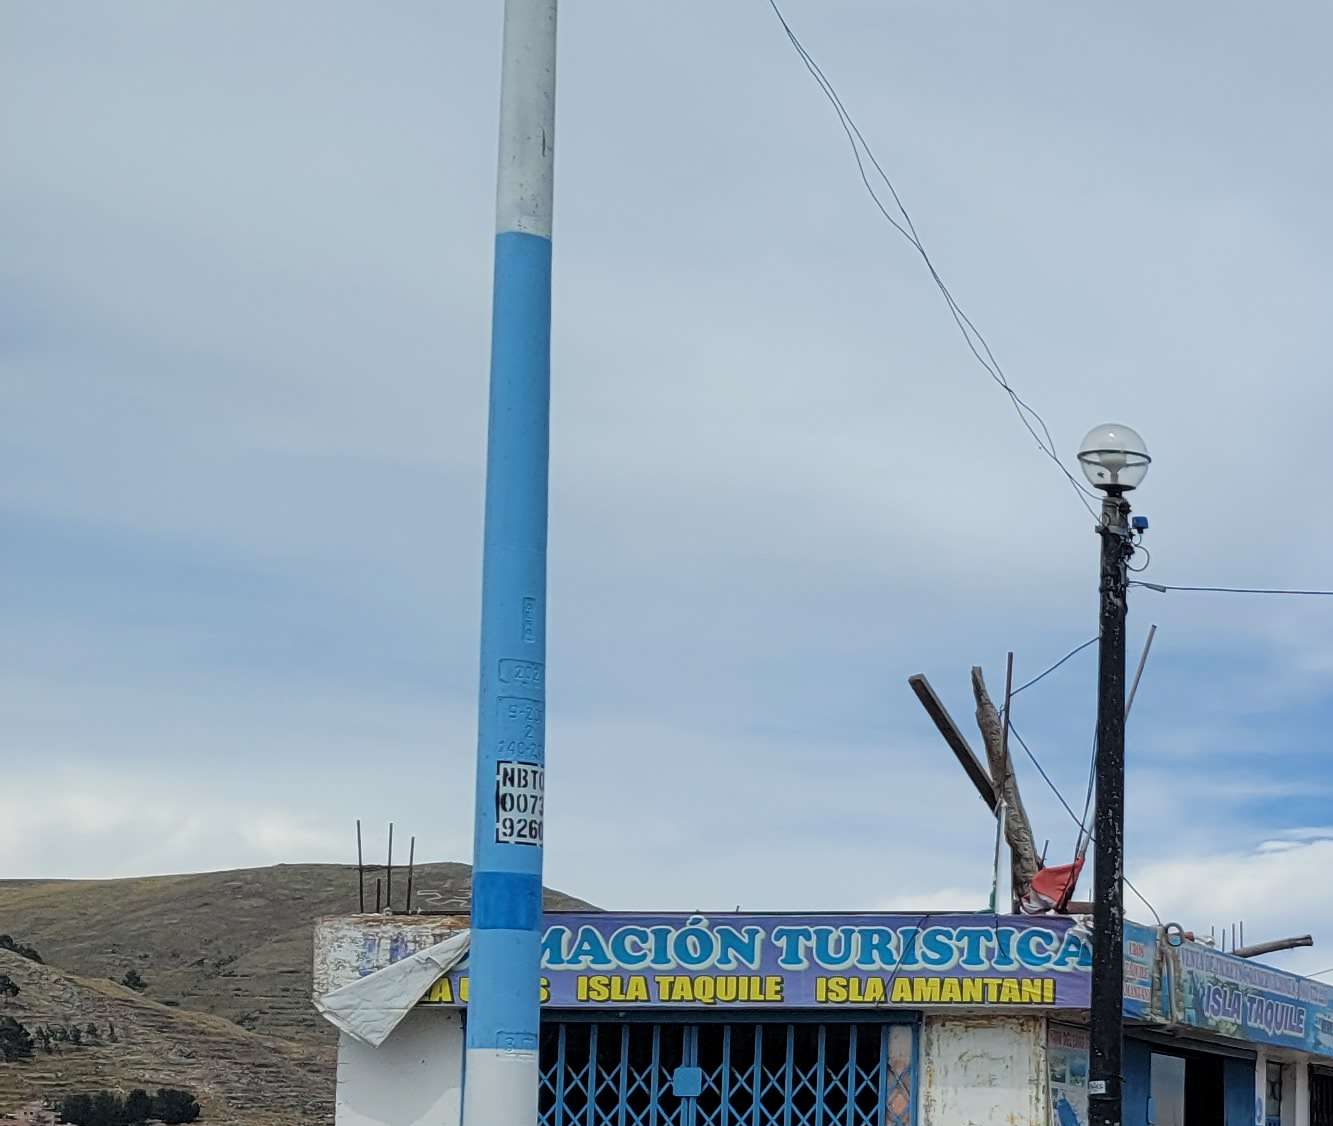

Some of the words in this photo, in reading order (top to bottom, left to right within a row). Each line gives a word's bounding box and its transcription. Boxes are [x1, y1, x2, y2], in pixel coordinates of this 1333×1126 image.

[773, 927, 1092, 970] TURISTICA
[577, 975, 649, 1002] ISLA
[655, 975, 784, 1004] TAQUILE
[816, 976, 886, 1003] ISLA
[889, 976, 1055, 1004] AMANTANI
[1205, 984, 1242, 1024] ISLA
[1247, 996, 1306, 1036] TAQUILE
